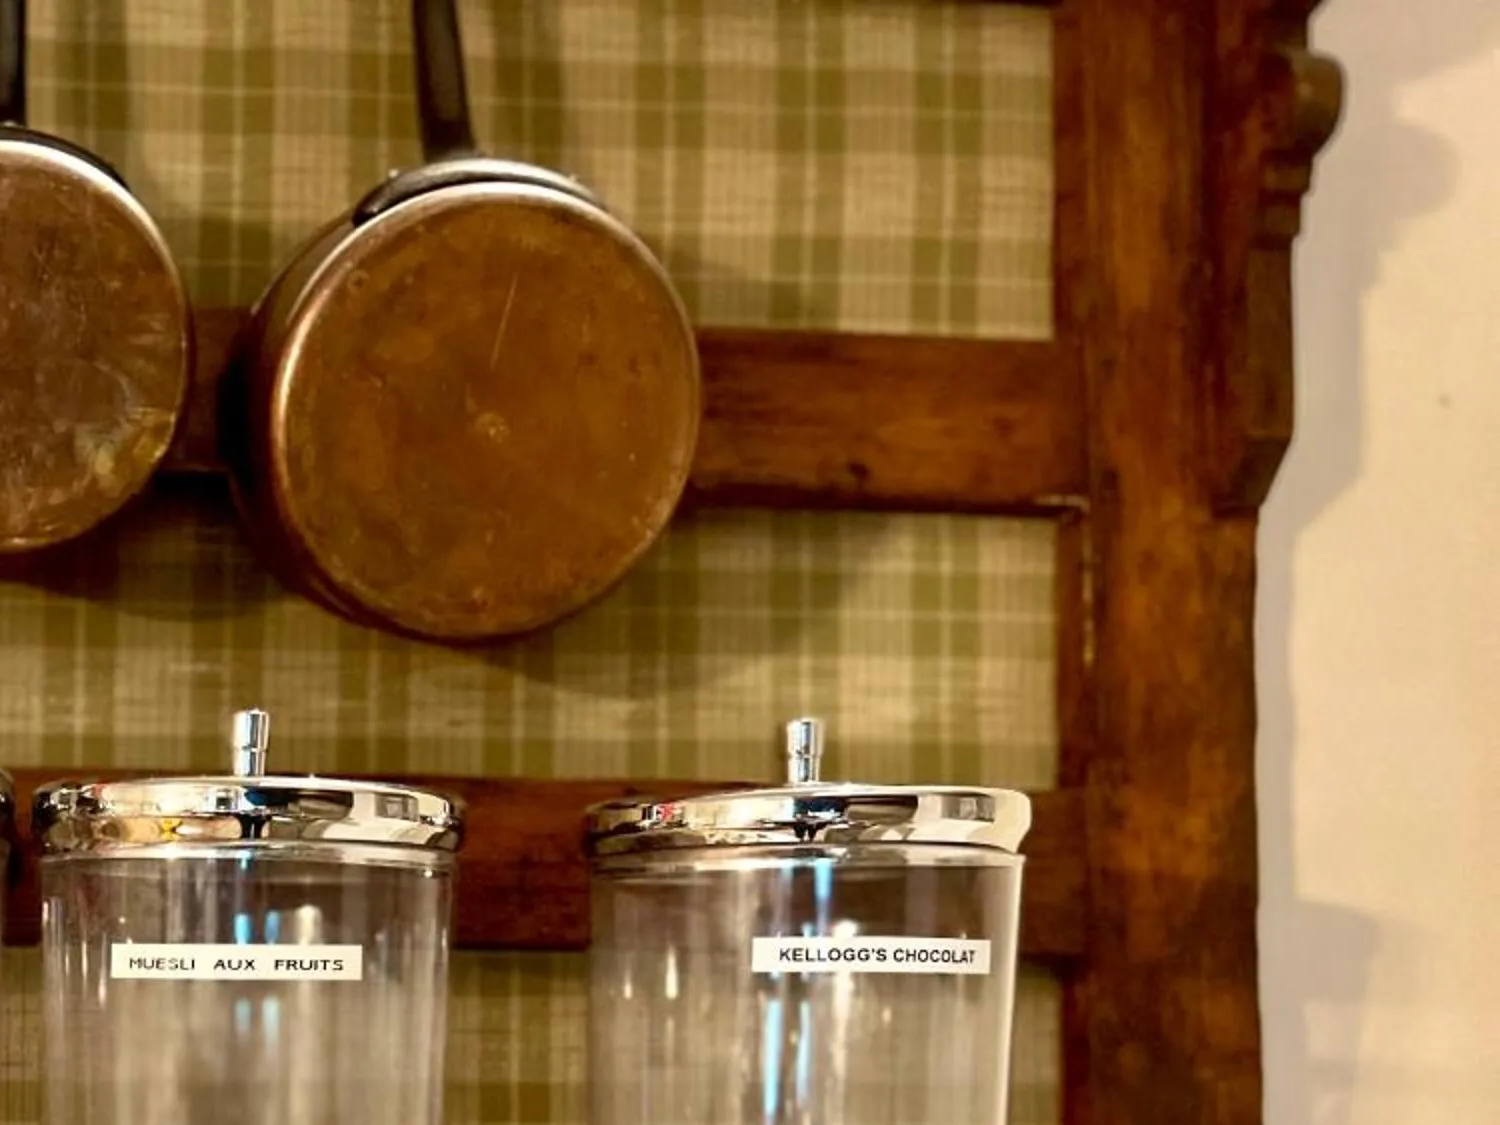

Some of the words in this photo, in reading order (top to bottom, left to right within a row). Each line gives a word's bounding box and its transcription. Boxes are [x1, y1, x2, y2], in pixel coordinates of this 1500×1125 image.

[779, 948, 887, 962] KELLOGG'S
[893, 949, 976, 963] CHOCOLAT
[129, 957, 196, 971] MUESLI
[213, 959, 256, 971] AUX
[274, 959, 344, 971] FRUITS
